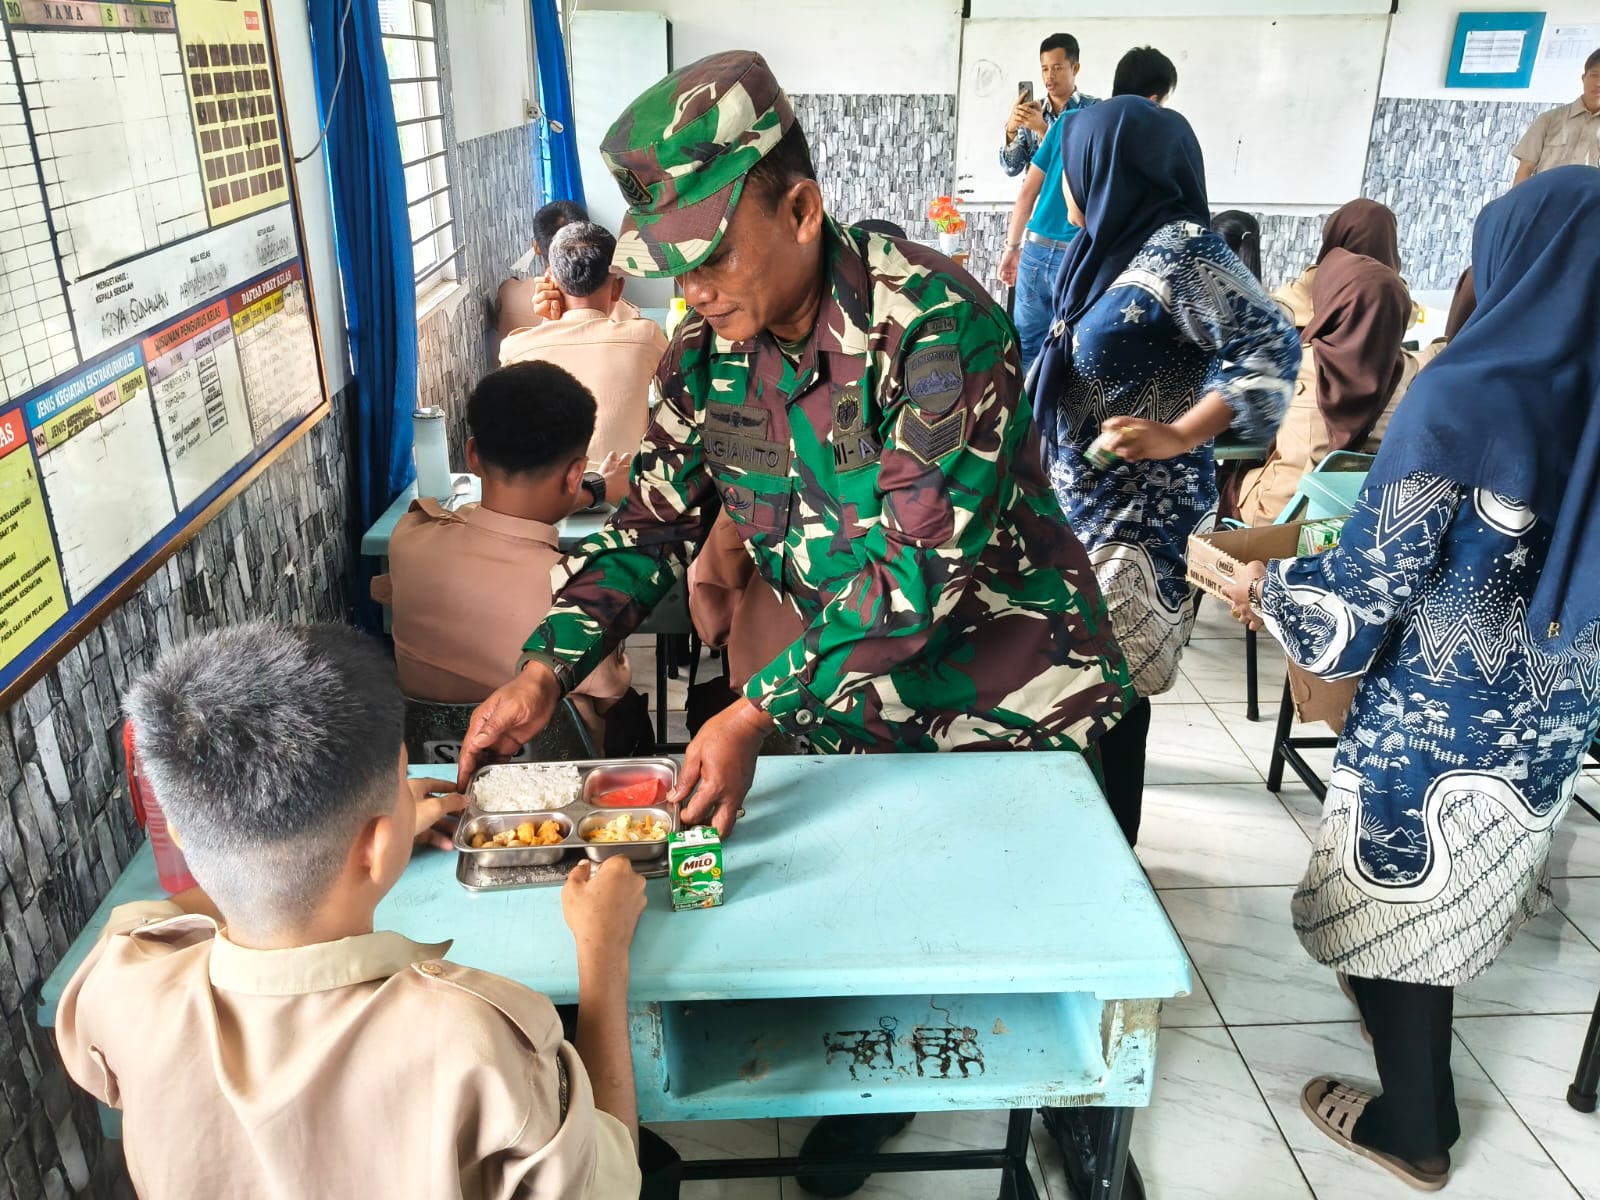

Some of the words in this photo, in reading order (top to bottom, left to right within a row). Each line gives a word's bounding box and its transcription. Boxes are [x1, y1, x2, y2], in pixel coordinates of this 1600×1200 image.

[6, 1, 21, 17] NO
[43, 4, 84, 21] NAMA
[106, 8, 114, 22] S
[36, 395, 56, 419] JENIS
[54, 379, 87, 408] KEGIATAN
[98, 390, 117, 408] WAKTU
[50, 419, 67, 439] JENIS
[34, 433, 45, 448] NO
[1219, 561, 1234, 573] MILO
[683, 858, 713, 872] MILO
